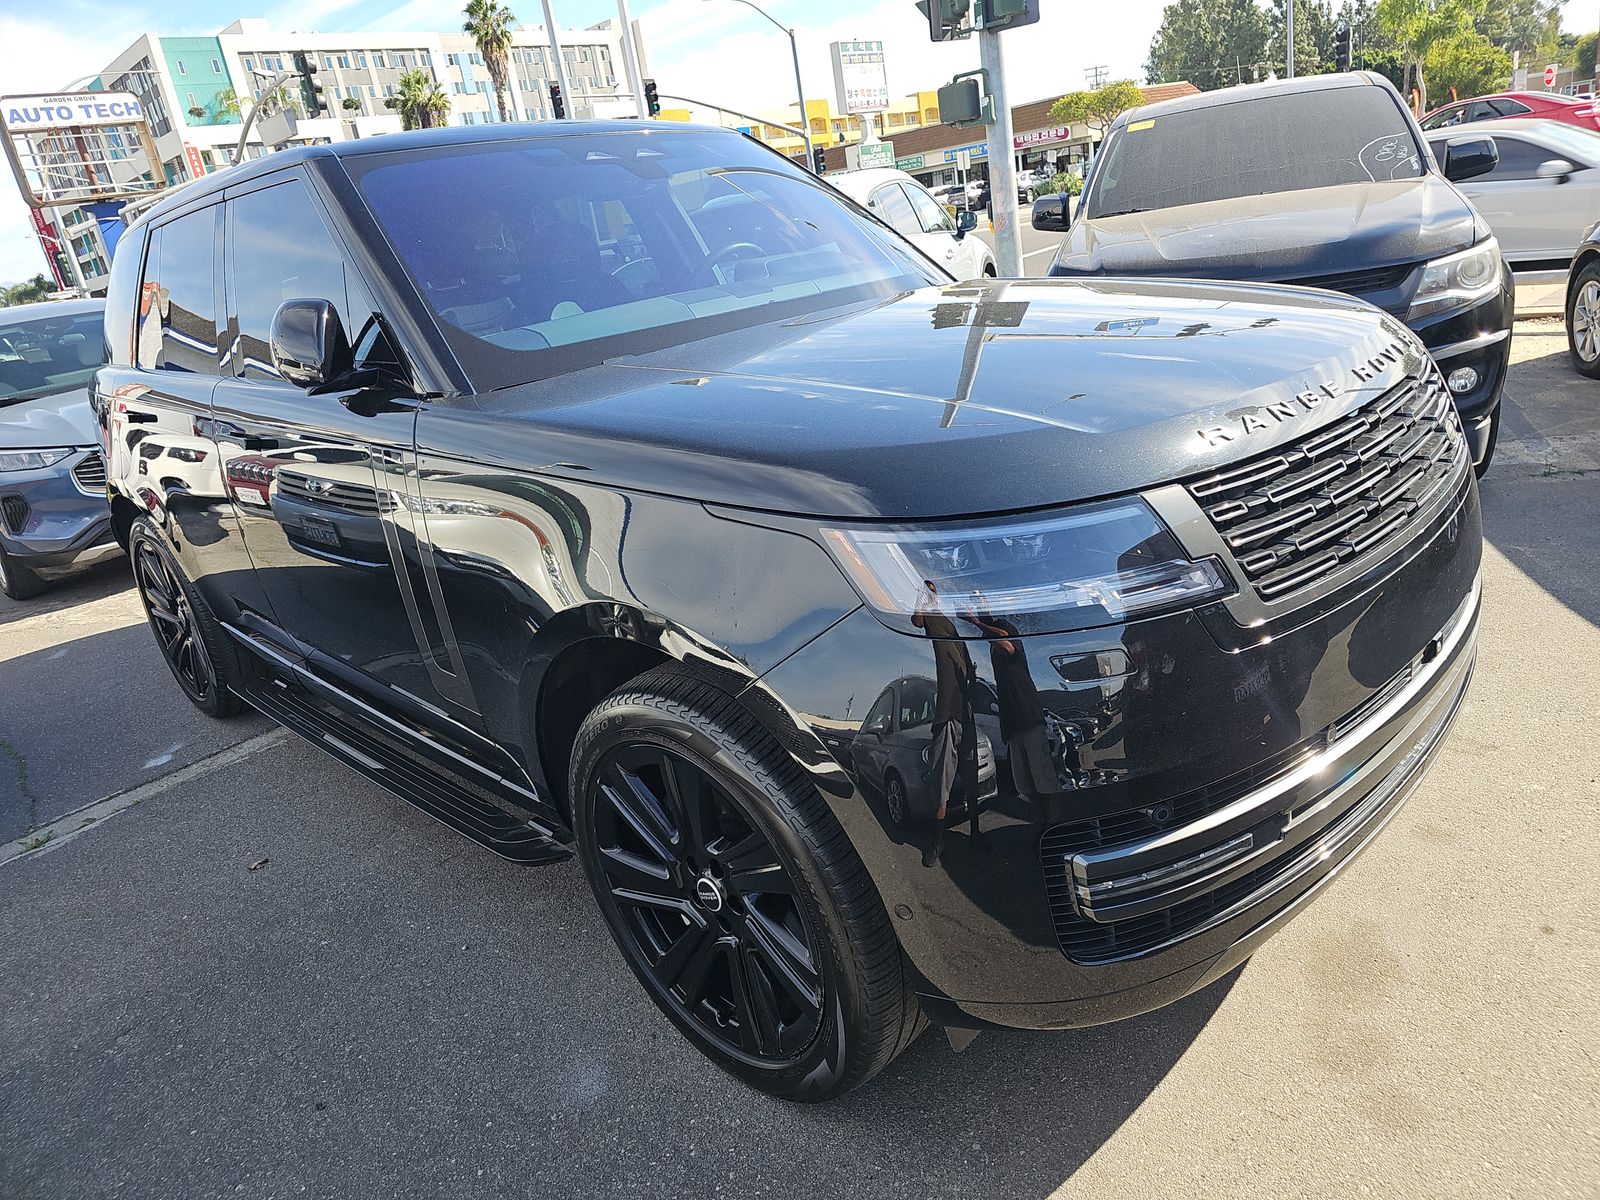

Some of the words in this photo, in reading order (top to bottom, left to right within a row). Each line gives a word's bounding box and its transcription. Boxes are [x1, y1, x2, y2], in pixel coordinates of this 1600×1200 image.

[9, 105, 73, 124] AUTO
[78, 101, 141, 119] TECH
[1197, 379, 1344, 446] RANGE
[1351, 332, 1414, 382] ROVER
